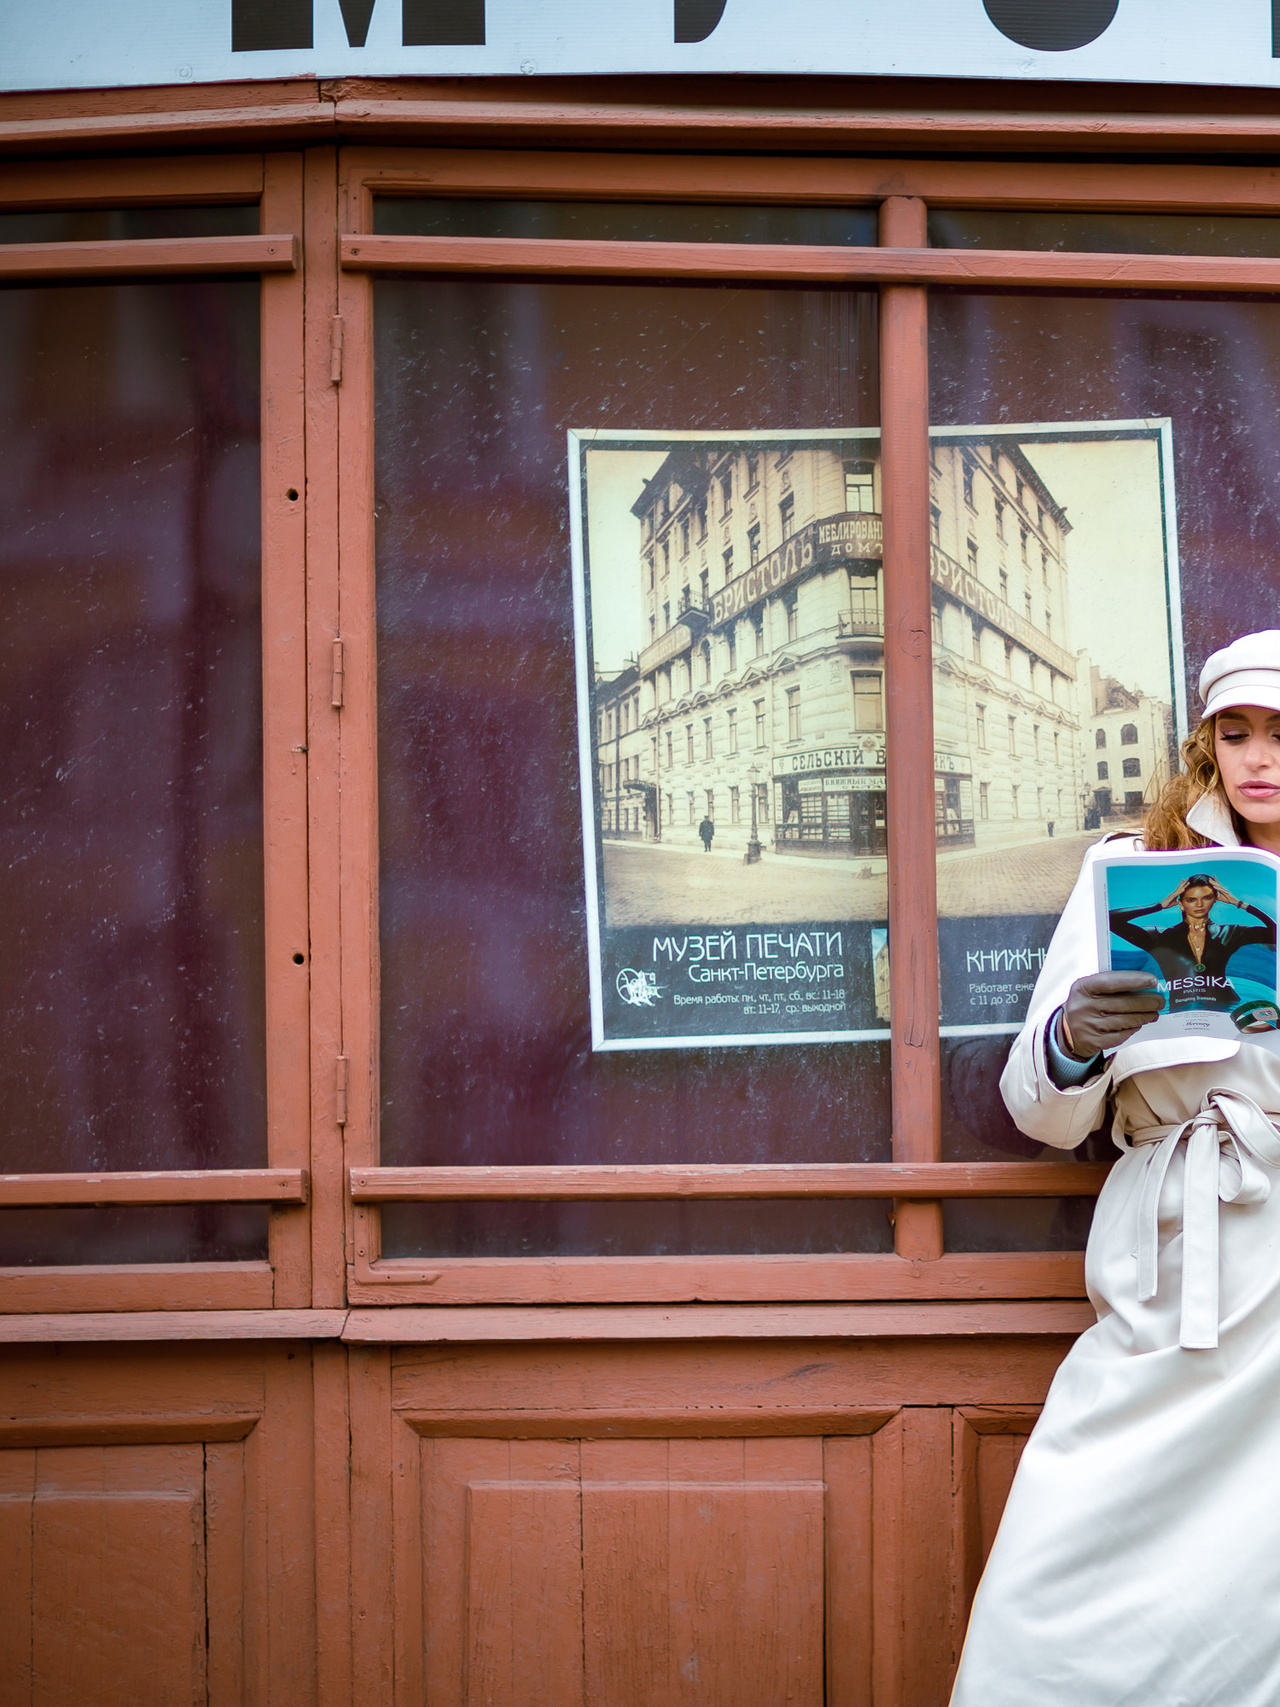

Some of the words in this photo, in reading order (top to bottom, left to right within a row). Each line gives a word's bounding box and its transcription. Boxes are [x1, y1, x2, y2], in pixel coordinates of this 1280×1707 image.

[818, 520, 883, 545] МЕБЛИРОВАН
[652, 930, 737, 962] МУЗЕЙ
[746, 931, 842, 959] ПЕЧАТИ
[688, 961, 845, 984] Санкт-Петербурга
[969, 982, 1013, 994] Работает
[1156, 975, 1235, 993] MESSIKA
[673, 994, 703, 1007] Время
[705, 992, 740, 1006] работы:
[970, 997, 977, 1006] с
[979, 995, 988, 1005] 11
[990, 996, 1003, 1006] до
[1005, 993, 1019, 1004] 20
